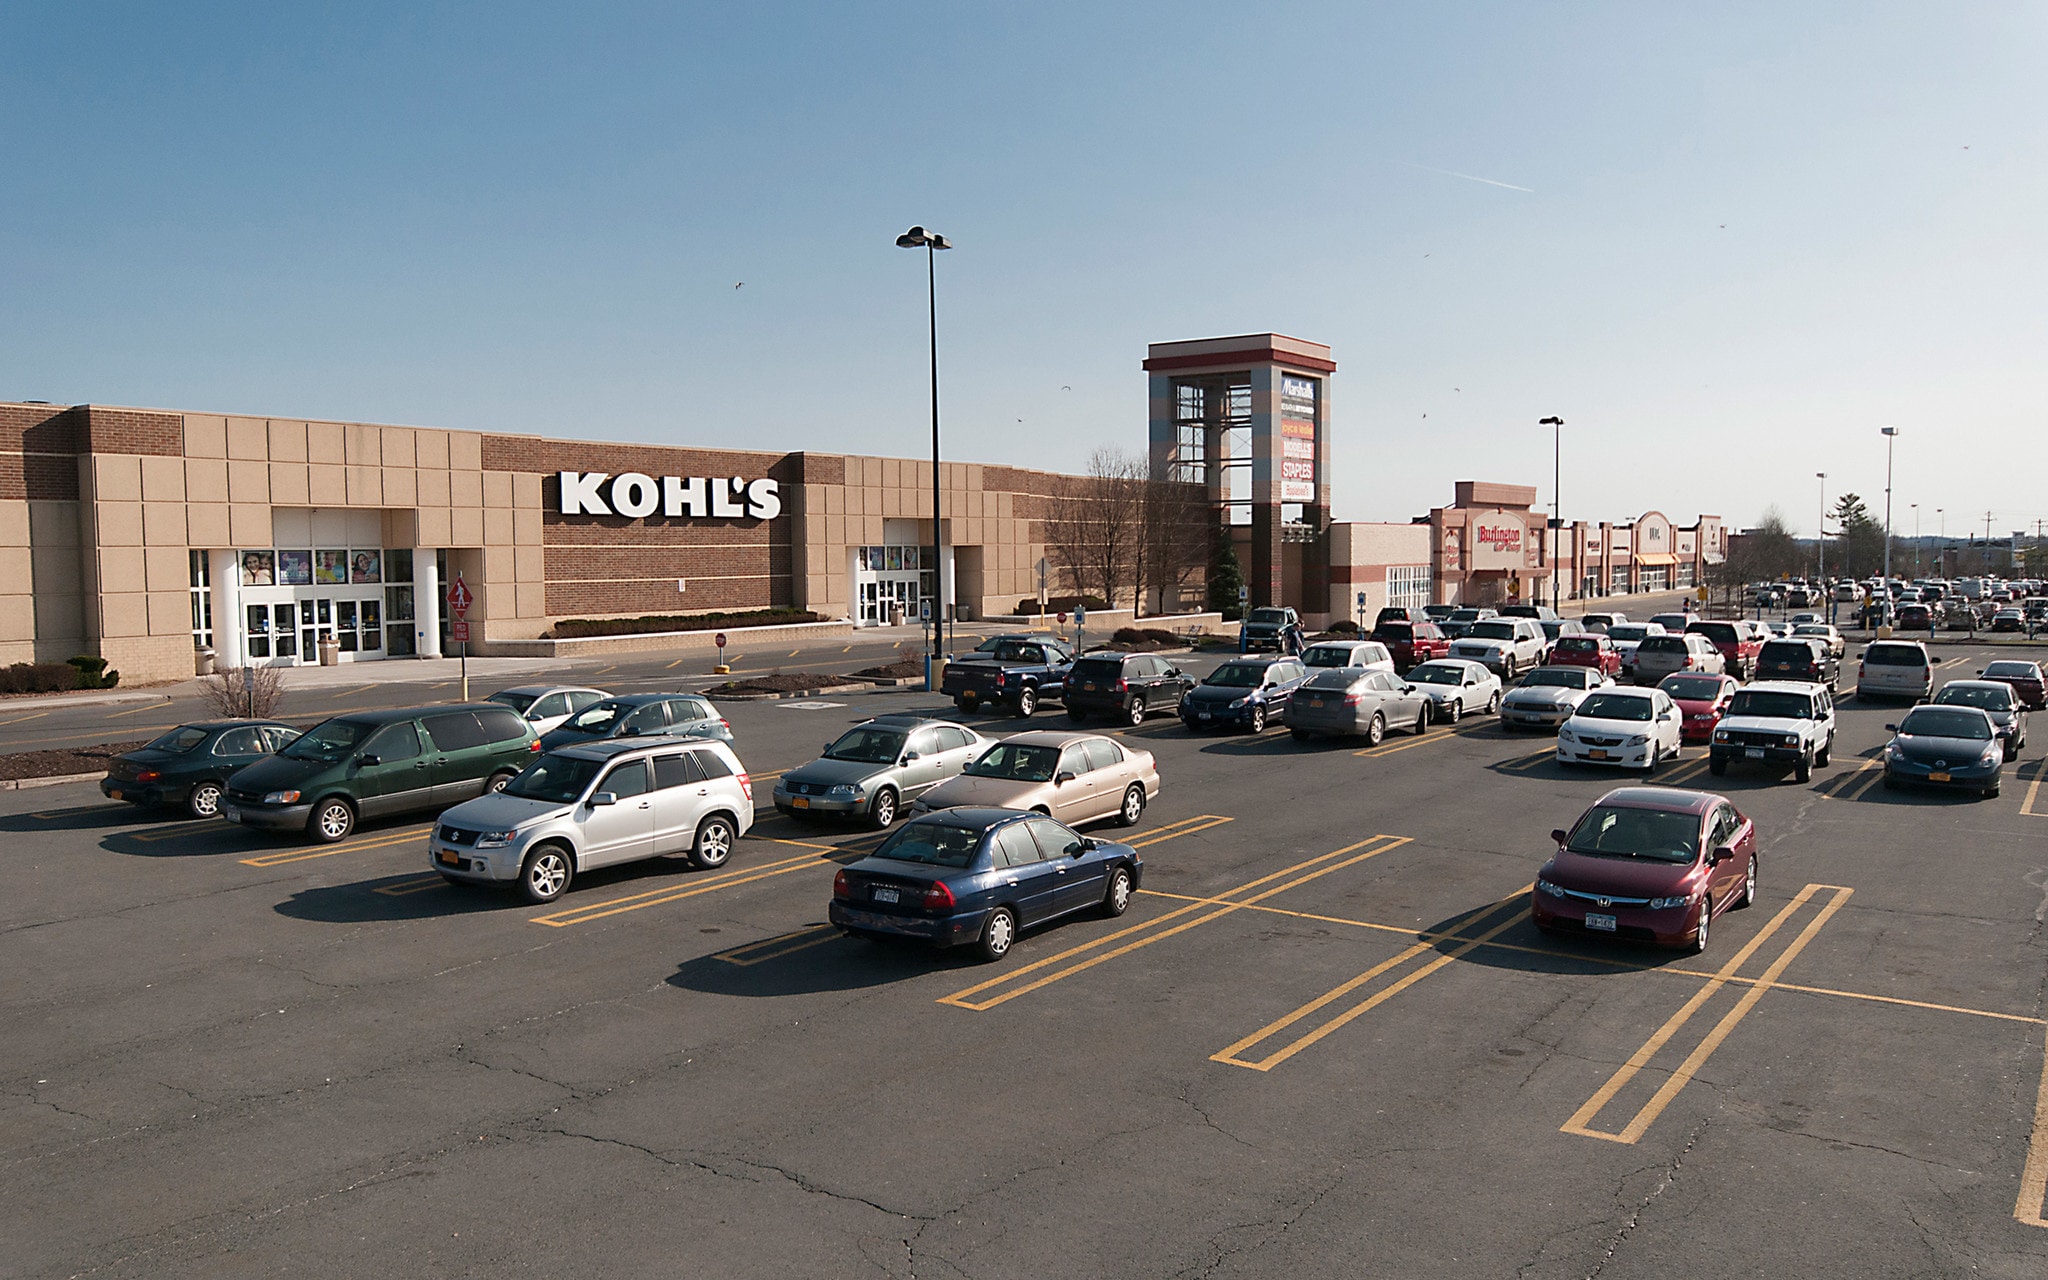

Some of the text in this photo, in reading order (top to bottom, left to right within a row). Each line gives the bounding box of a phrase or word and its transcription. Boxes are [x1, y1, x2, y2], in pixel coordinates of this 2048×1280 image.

[1282, 462, 1312, 479] STAPLES
[560, 471, 781, 520] KOHL'S
[1478, 525, 1520, 546] Burlington
